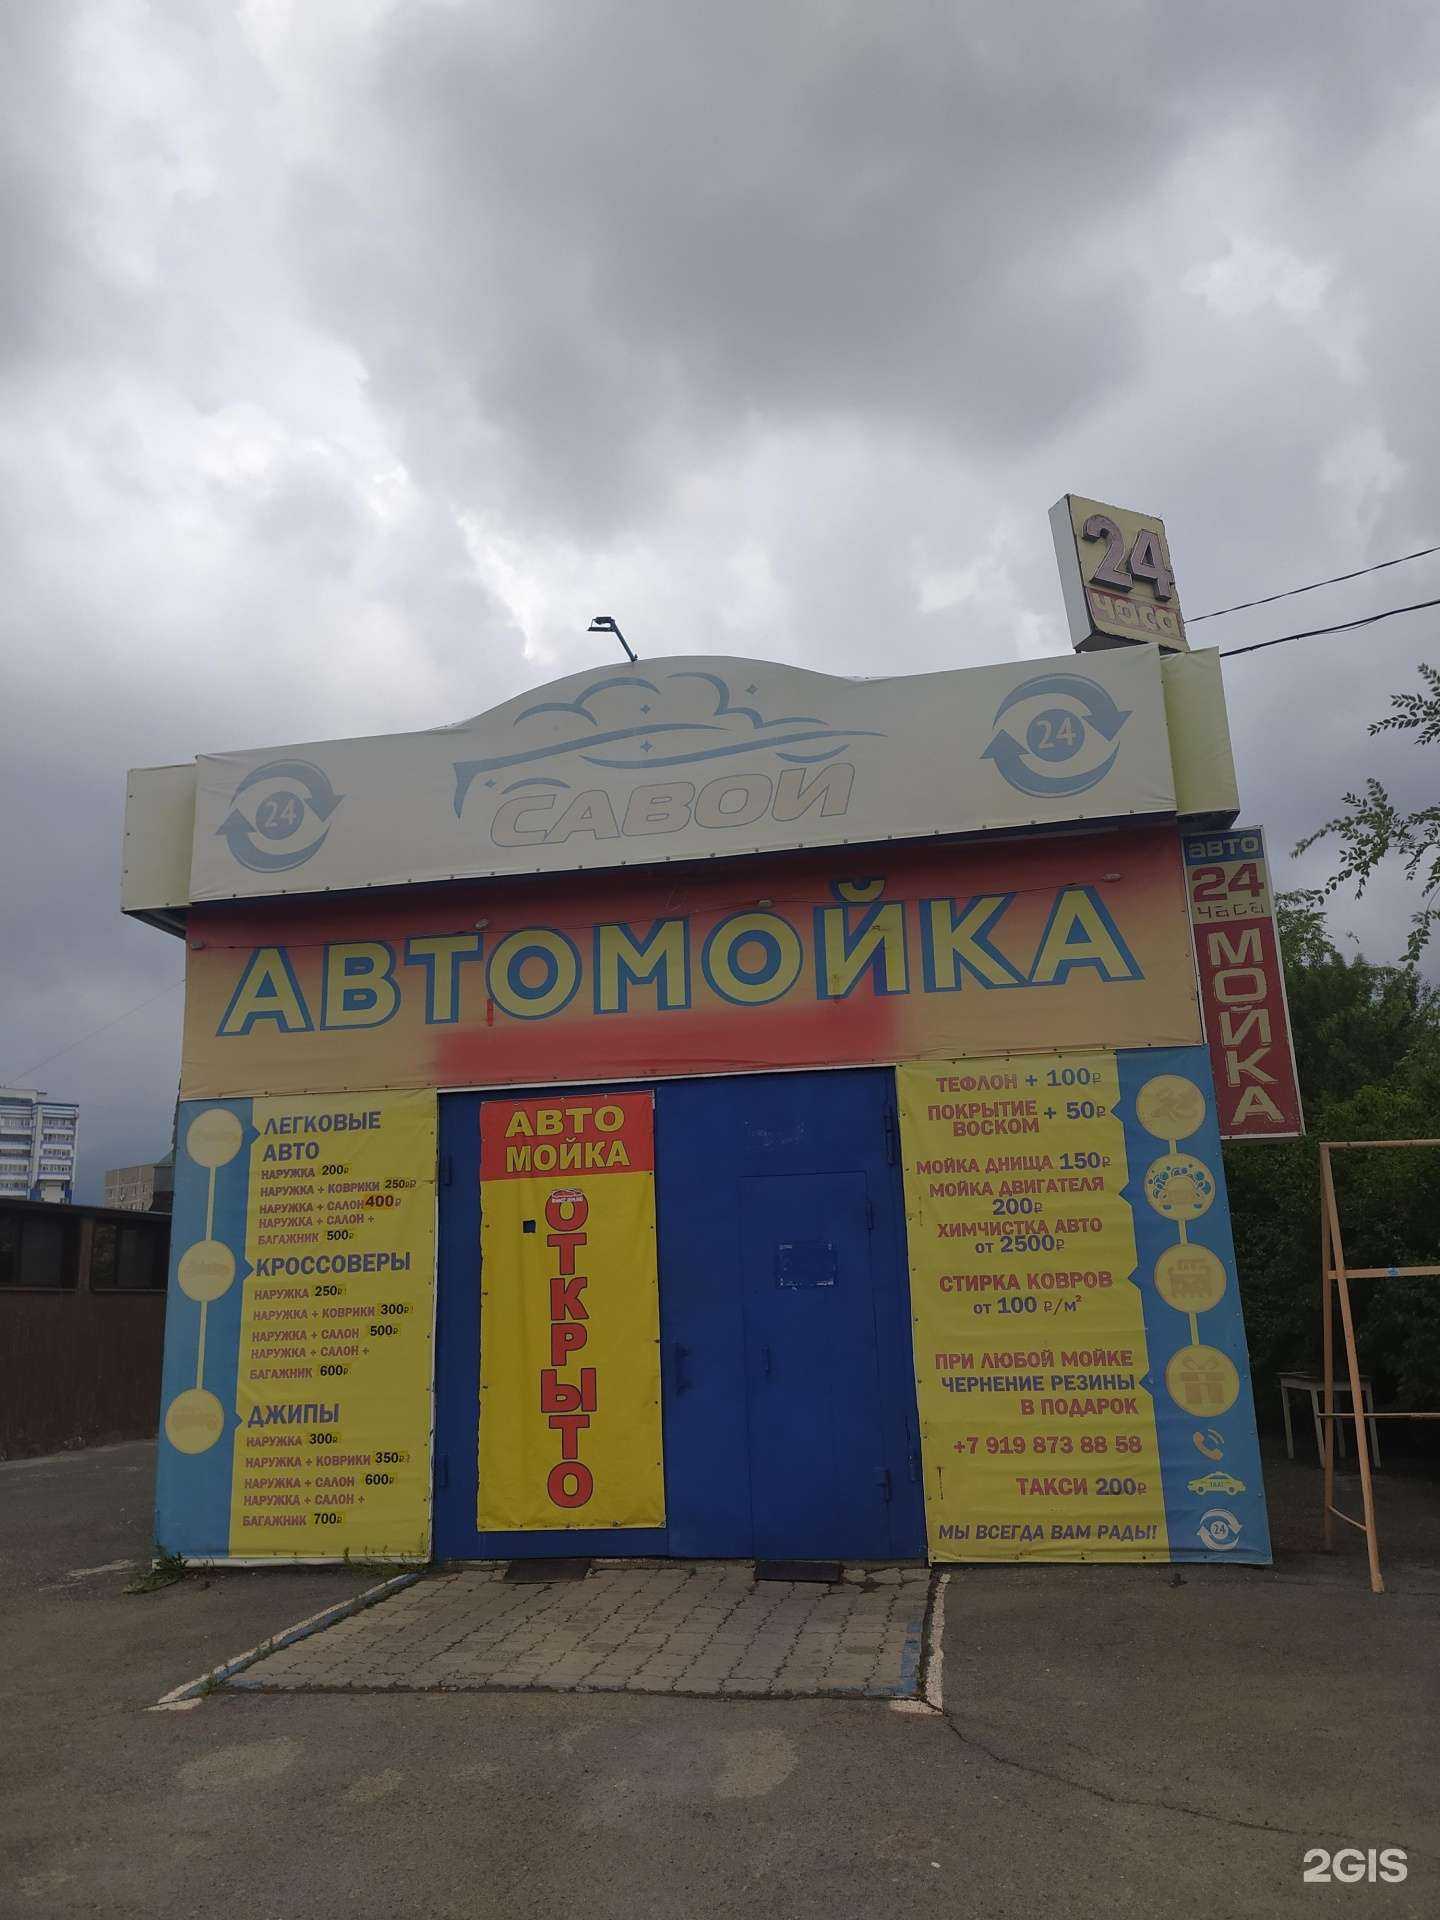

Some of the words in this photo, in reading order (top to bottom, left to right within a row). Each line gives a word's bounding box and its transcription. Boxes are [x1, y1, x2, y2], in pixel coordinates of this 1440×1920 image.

[1082, 513, 1172, 602] 24
[1037, 718, 1076, 749] 24
[265, 799, 296, 827] 24
[1192, 863, 1264, 902] 24
[215, 878, 1147, 1036] АВТОМОЙКА
[1208, 928, 1285, 1126] МОЙКА
[936, 1074, 1018, 1092] ТЕФЛОН
[1026, 1075, 1037, 1086] +
[928, 1101, 1037, 1120] ПОКРЫТИЕ
[1044, 1107, 1056, 1119] +
[264, 1112, 381, 1136] ЛЕГКОВЫЕ
[504, 1105, 626, 1139] АВТО
[953, 1118, 1039, 1136] ВОСКОМ
[263, 1142, 319, 1162] АВТО
[506, 1137, 631, 1173] МОЙКА
[261, 1168, 315, 1179] НАРУЖКА
[917, 1157, 979, 1174] МОЙКА
[985, 1156, 1053, 1173] ДНИЩА
[261, 1186, 314, 1197] НАРУЖКА
[328, 1181, 380, 1193] КОВРИКИ
[930, 1180, 993, 1197] МОЙКА
[999, 1177, 1104, 1197] ДВИГАТЕЛЯ
[260, 1203, 313, 1214] НАРУЖКА
[327, 1199, 364, 1211] САЛОН
[259, 1217, 313, 1228] НАРУЖКА
[327, 1214, 364, 1225] САЛОН
[938, 1220, 1048, 1238] ХИМЧИСТКА
[1055, 1218, 1102, 1233] АВТО
[258, 1233, 319, 1245] БАГАЖНИК
[256, 1252, 411, 1276] КРОССОВЕРЫ
[939, 1274, 1020, 1292] СТИРКА
[1028, 1271, 1113, 1290] КОВРОВ
[255, 1289, 309, 1300] НАРУЖКА
[253, 1309, 308, 1321] НАРУЖКА
[322, 1307, 375, 1318] КОВРИКИ
[252, 1330, 307, 1342] НАРУЖКА
[321, 1328, 359, 1340] САЛОН
[251, 1347, 306, 1359] НАРУЖКА
[321, 1345, 359, 1357] САЛОН
[540, 1189, 597, 1509] ОТКРЫТО
[935, 1353, 974, 1370] ПРИ
[981, 1350, 1055, 1369] ЛЮБОЙ
[1061, 1348, 1133, 1368] МОЙКЕ
[250, 1368, 313, 1379] БАГАЖНИК
[941, 1375, 1044, 1392] ЧЕРНЕНИЕ
[1052, 1374, 1135, 1391] РЕЗИНЫ
[248, 1403, 339, 1428] ДЖИПЫ
[1021, 1401, 1034, 1415] В
[1041, 1398, 1138, 1417] ПОДАРОК
[247, 1435, 303, 1447] НАРУЖКА
[954, 1437, 979, 1454] +7
[986, 1437, 1026, 1454] 919
[1033, 1437, 1074, 1454] 873
[1081, 1436, 1108, 1453] 88
[1115, 1436, 1142, 1453] 58
[246, 1456, 302, 1468] НАРУЖКА
[316, 1455, 371, 1467] КОВРИКИ
[245, 1477, 301, 1489] НАРУЖКА
[315, 1477, 355, 1488] САЛОН
[1016, 1478, 1088, 1496] ТАКСИ
[244, 1495, 300, 1506] НАРУЖКА
[315, 1494, 354, 1505] САЛОН
[243, 1515, 306, 1526] БАГАЖНИК
[939, 1525, 969, 1540] МЫ
[976, 1525, 1044, 1541] ВСЕГДА
[1051, 1525, 1091, 1539] ВАМ
[1097, 1525, 1157, 1541] РАДЫ!
